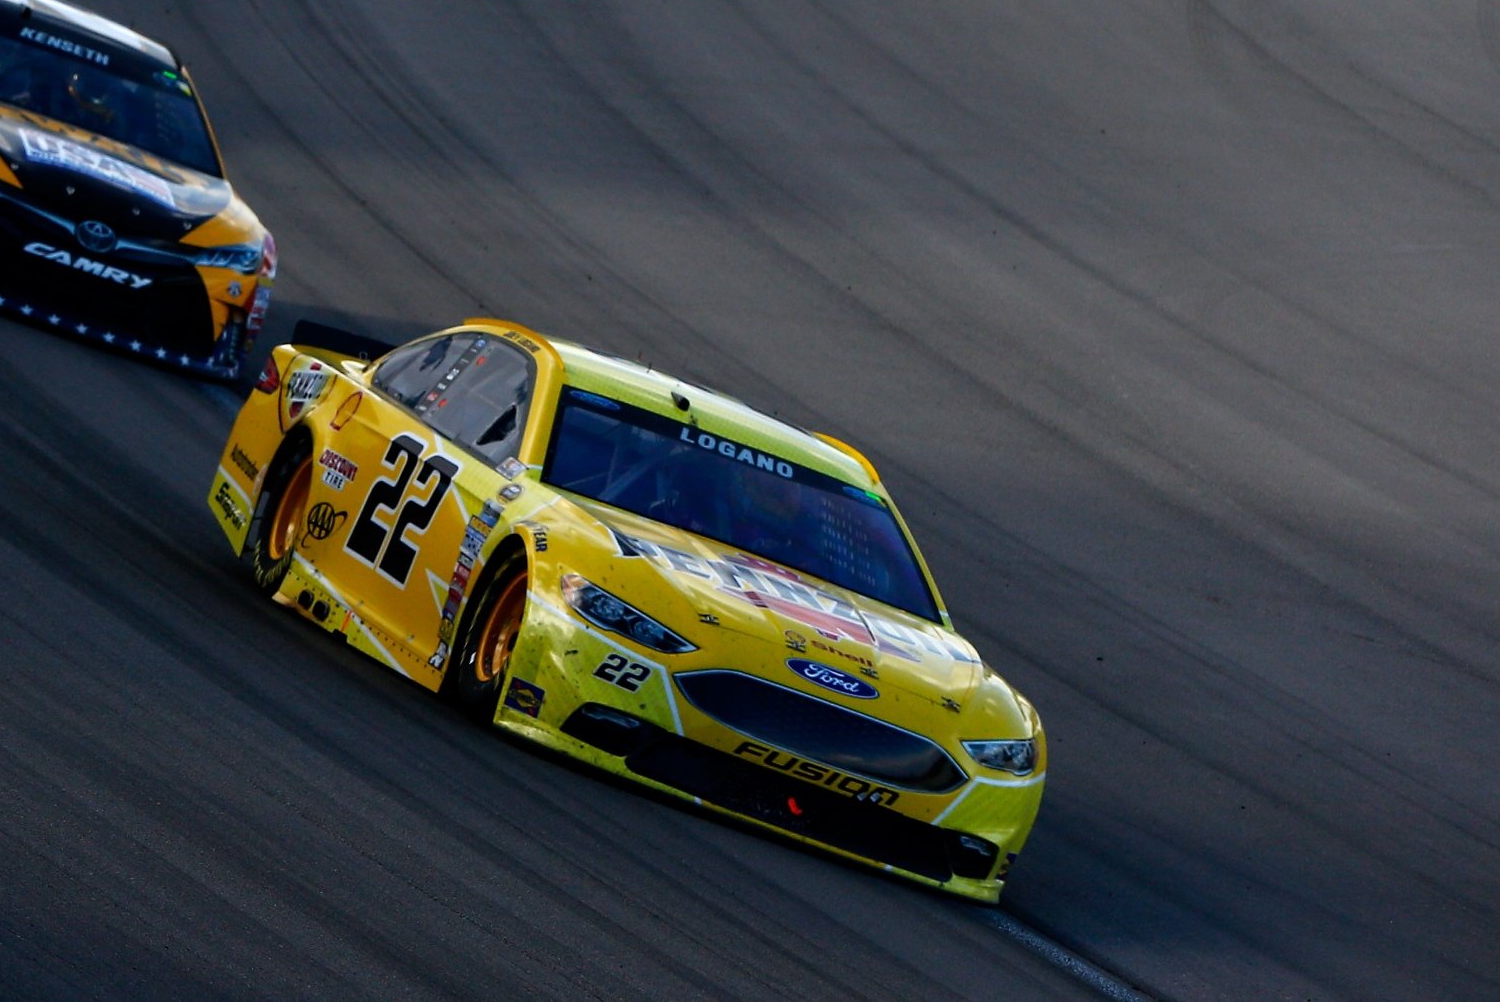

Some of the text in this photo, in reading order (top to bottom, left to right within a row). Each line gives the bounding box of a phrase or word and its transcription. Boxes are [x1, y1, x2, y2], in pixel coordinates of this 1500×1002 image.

[19, 25, 111, 66] KENSETH
[23, 241, 155, 290] CAMRY
[319, 449, 358, 482] DISCOUNT
[679, 426, 794, 479] LOGANO
[324, 471, 344, 489] TIRE
[345, 432, 461, 588] 22
[593, 653, 650, 693] 22
[810, 640, 872, 667] Shell
[804, 664, 859, 694] Ford
[734, 742, 899, 806] FUSION
